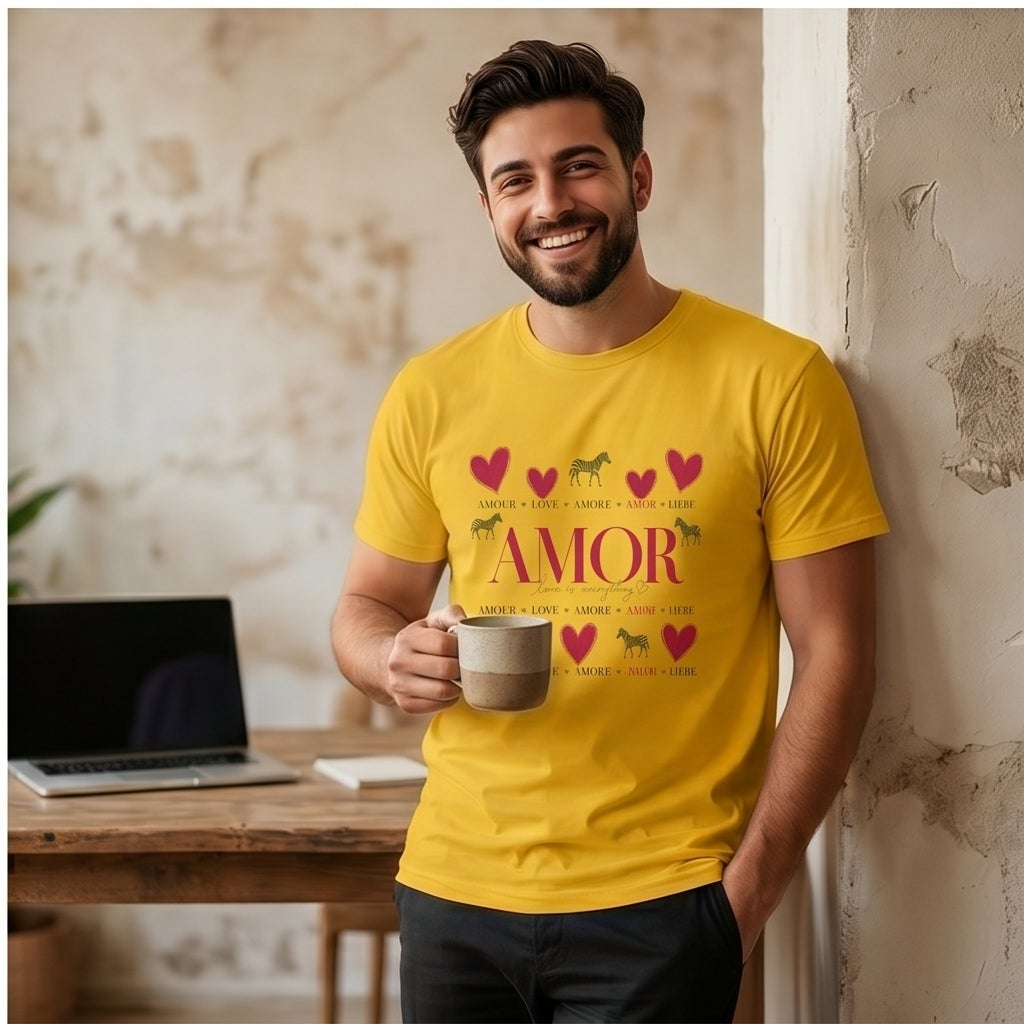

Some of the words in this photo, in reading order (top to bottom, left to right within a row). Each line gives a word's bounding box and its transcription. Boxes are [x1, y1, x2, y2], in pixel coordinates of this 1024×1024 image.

[477, 499, 516, 509] AMOUR
[531, 499, 559, 509] LOVE
[573, 499, 612, 509] AMORE
[625, 499, 657, 509] AMOR
[668, 499, 696, 509] LIEBE
[487, 526, 685, 585] AMOR
[531, 605, 559, 616] LOVE
[573, 605, 612, 616] AMORE
[575, 666, 612, 677] AMORE
